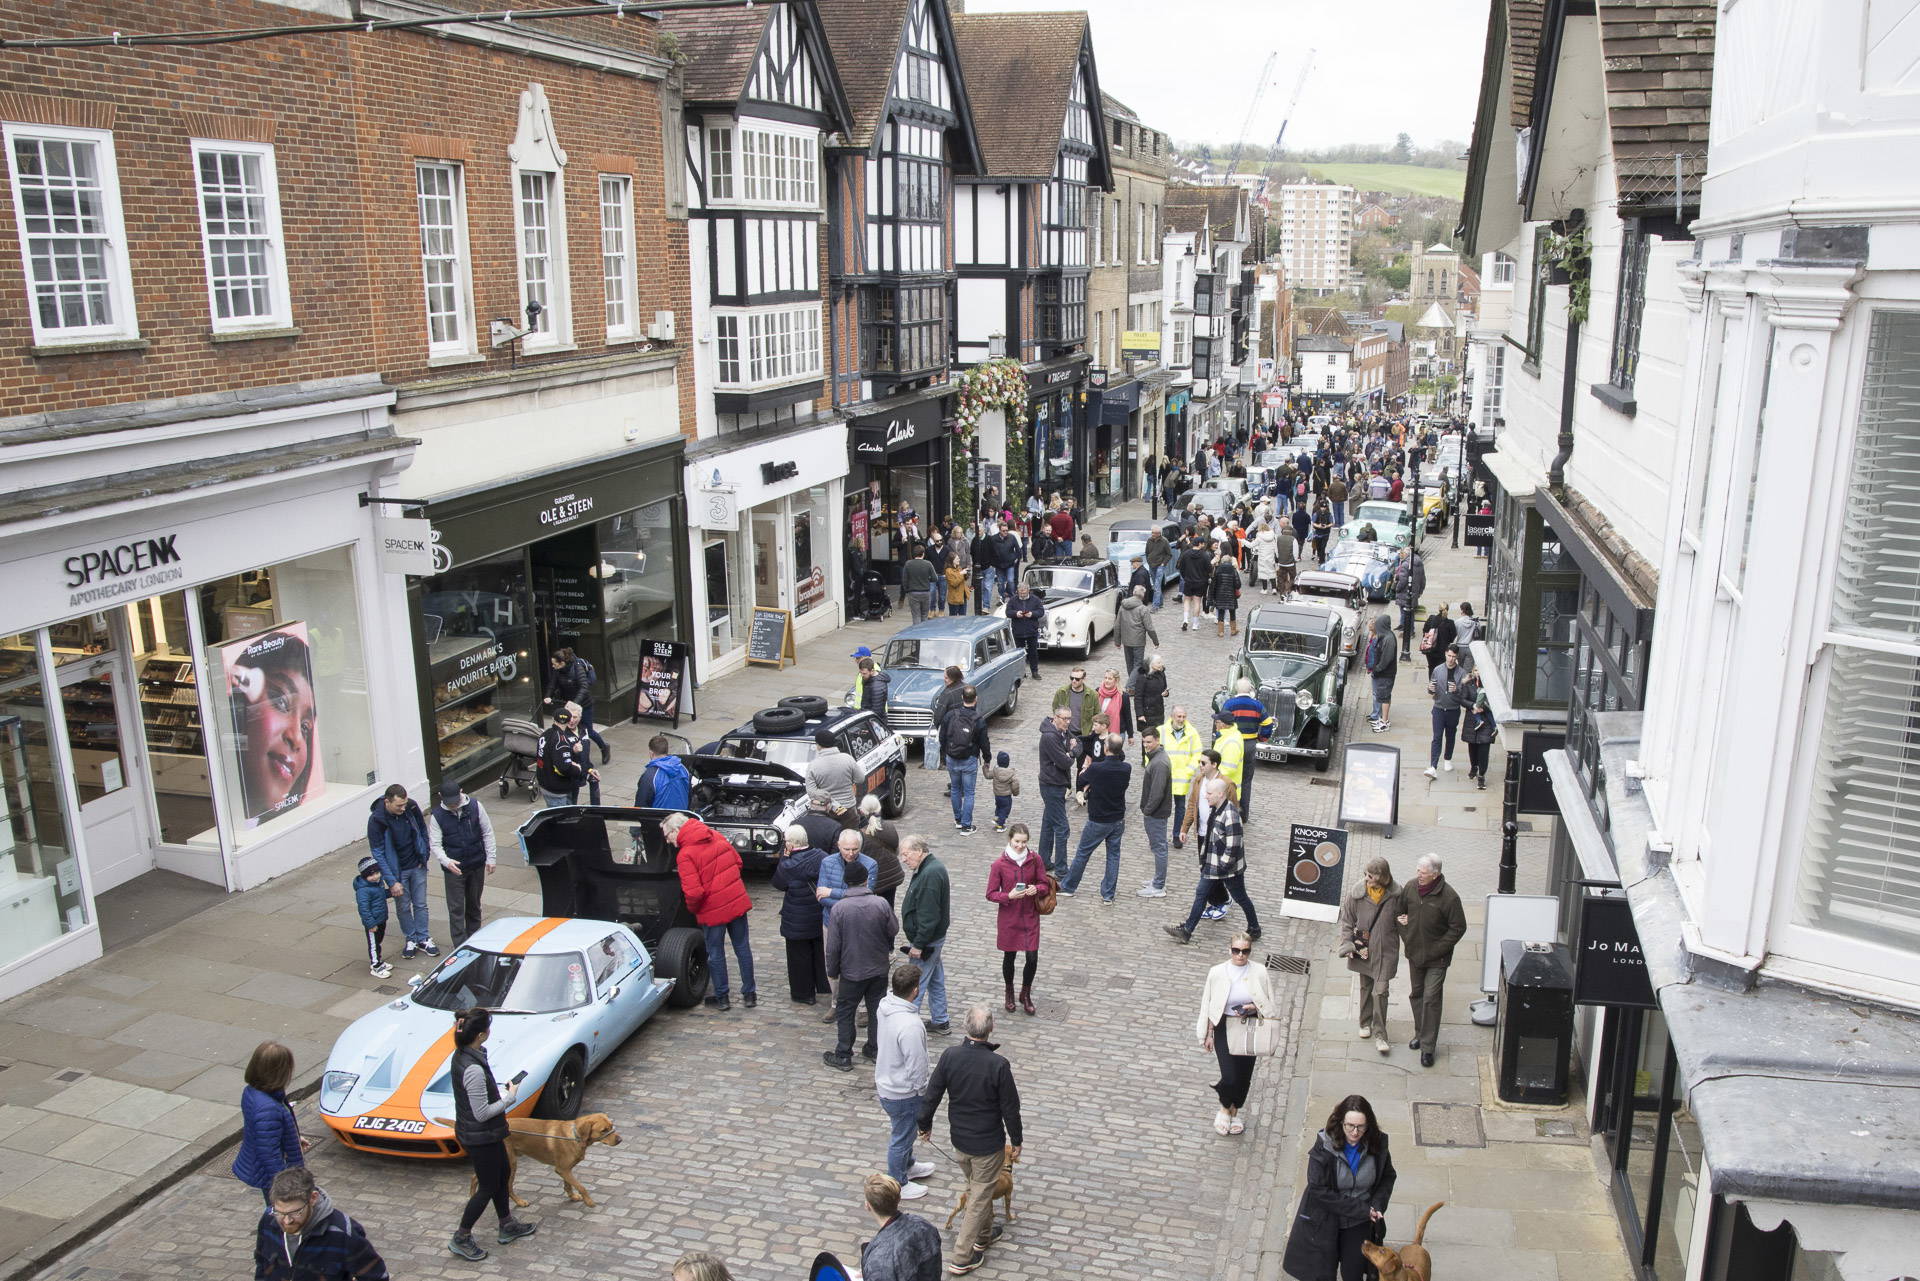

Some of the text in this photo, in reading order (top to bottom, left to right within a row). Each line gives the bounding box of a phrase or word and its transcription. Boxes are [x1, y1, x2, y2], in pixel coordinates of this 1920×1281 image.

[887, 418, 914, 446] Clarks
[858, 442, 884, 452] Clarks
[540, 496, 594, 524] OLE & STEEN
[856, 518, 864, 530] SALE
[384, 538, 424, 551] SPACENK
[64, 534, 181, 588] SPACENK
[70, 566, 183, 608] APOTHECARY LONDON
[247, 644, 262, 654] Rare
[262, 637, 285, 650] Beauty
[654, 642, 666, 650] OLE
[460, 642, 504, 670] DENMARK'S
[447, 652, 518, 692] FAVOURITE BAKERY
[652, 672, 671, 680] YOUR
[650, 680, 670, 688] DAILY
[1528, 764, 1543, 772] Jo
[1294, 827, 1328, 839] KNOOPS
[1588, 940, 1608, 951] Jo
[354, 1116, 426, 1134] RJG 240G
